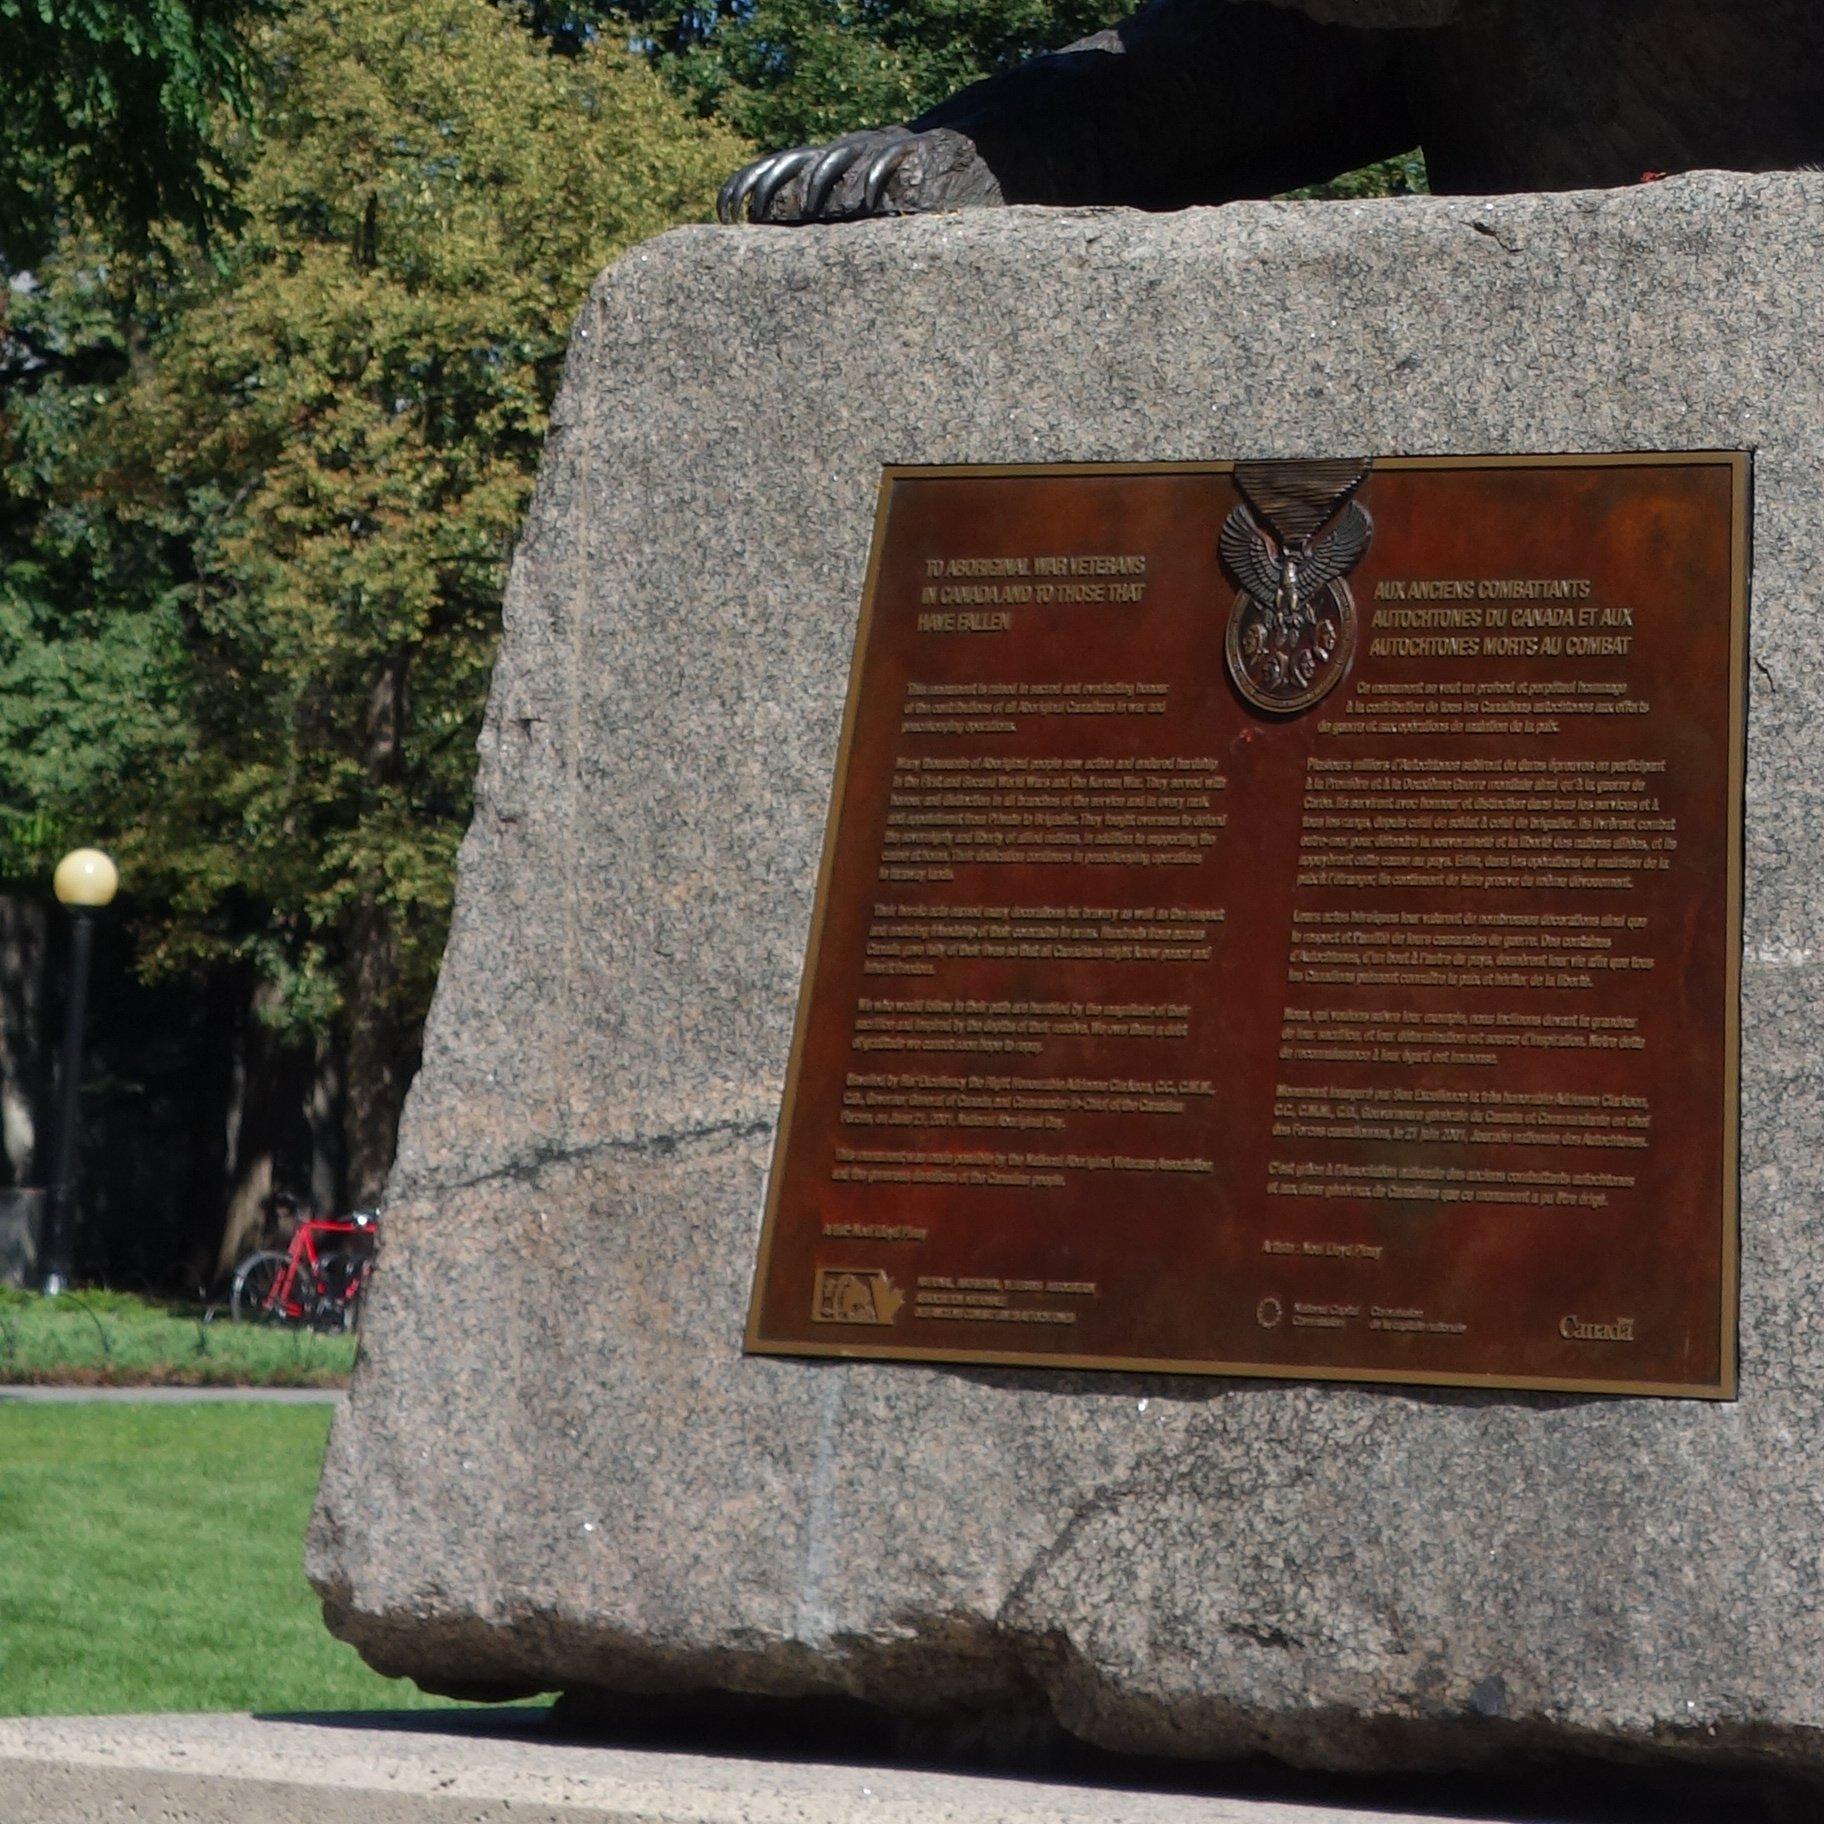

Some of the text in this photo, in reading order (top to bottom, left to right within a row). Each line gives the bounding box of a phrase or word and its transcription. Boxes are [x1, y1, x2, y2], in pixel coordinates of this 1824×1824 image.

[925, 556, 1146, 578] TO ABORIGINAL WAR VETERANS
[921, 583, 1146, 605] IN CANADA AND TO THOSE THAT
[1375, 580, 1590, 600] AUX ANCIENS COMBATTANTS
[917, 612, 1011, 632] HAVE FALLEN
[1371, 607, 1632, 627] AUTOCHTONES DU CANADA ET AUX
[1369, 635, 1632, 656] AUTOCHTONES MORTS AU COMBAT
[1558, 1315, 1634, 1341] Canada
